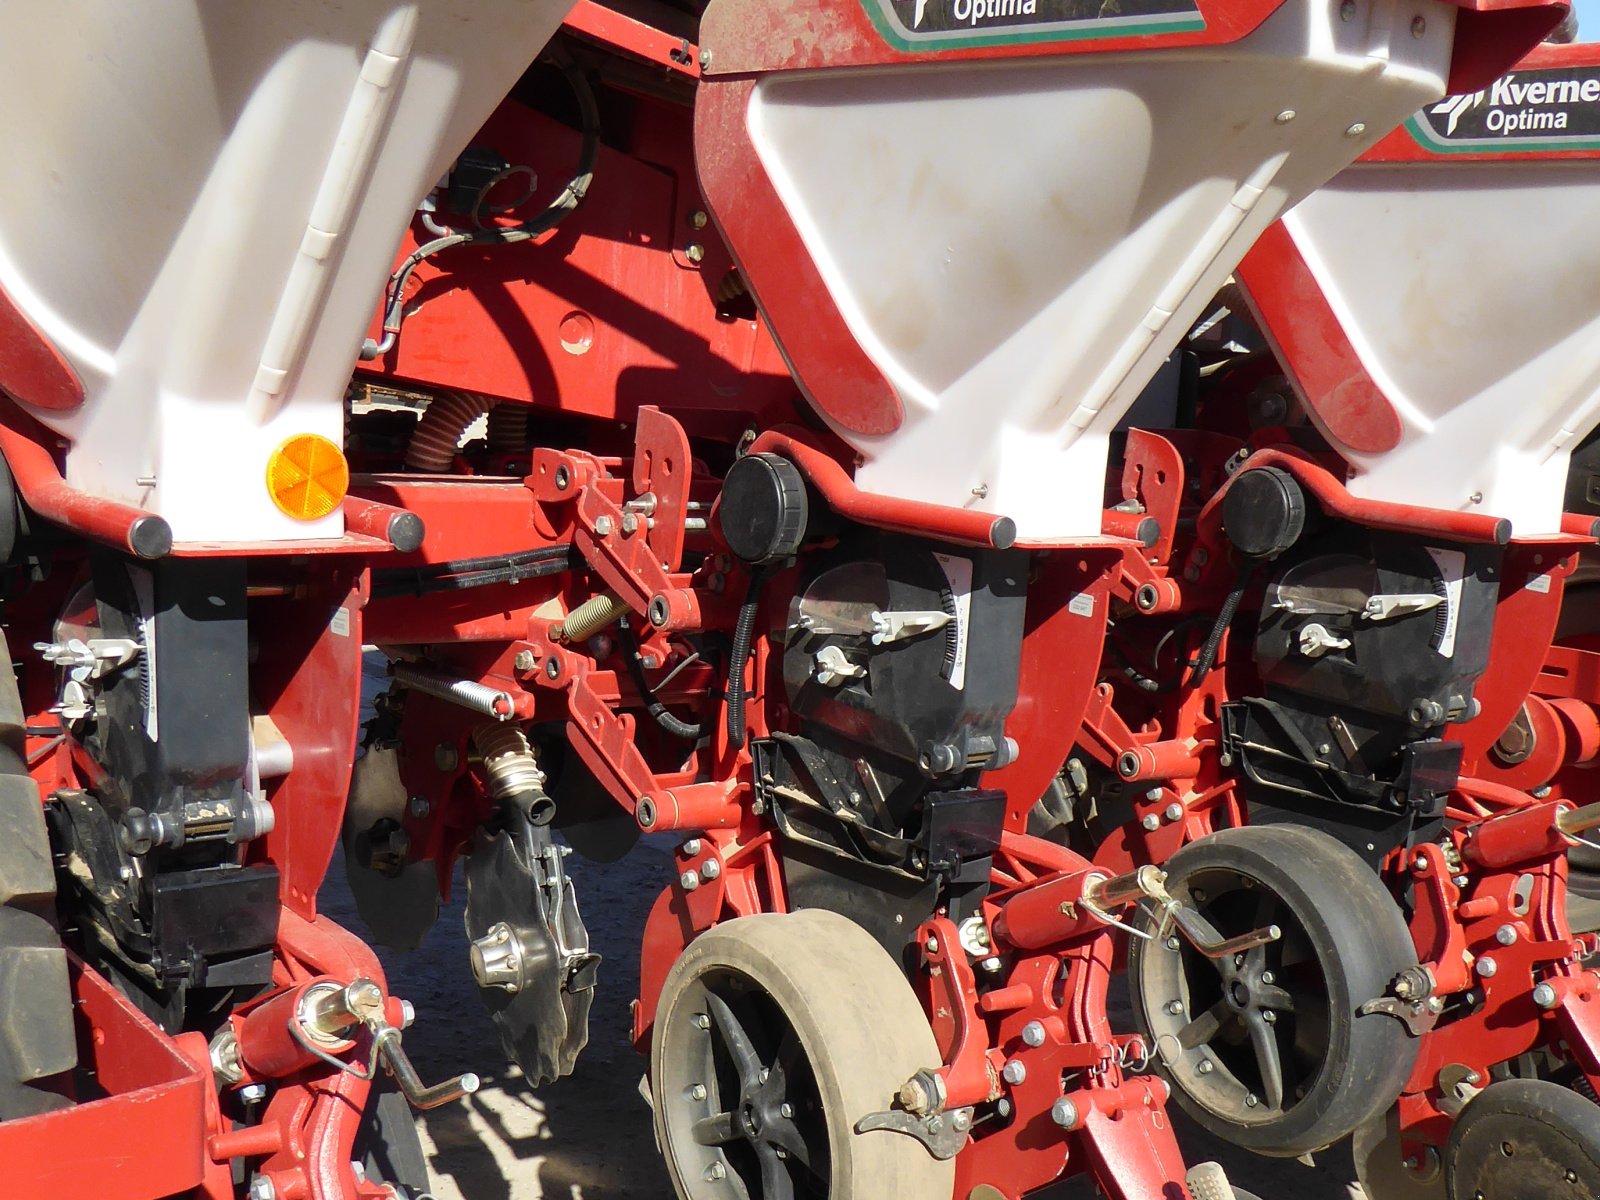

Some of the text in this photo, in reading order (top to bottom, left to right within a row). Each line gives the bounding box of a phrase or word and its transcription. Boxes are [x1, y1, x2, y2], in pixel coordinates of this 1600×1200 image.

[953, 0, 1036, 25] Optima
[1490, 75, 1600, 106] Kverne
[1486, 107, 1568, 135] Optima
